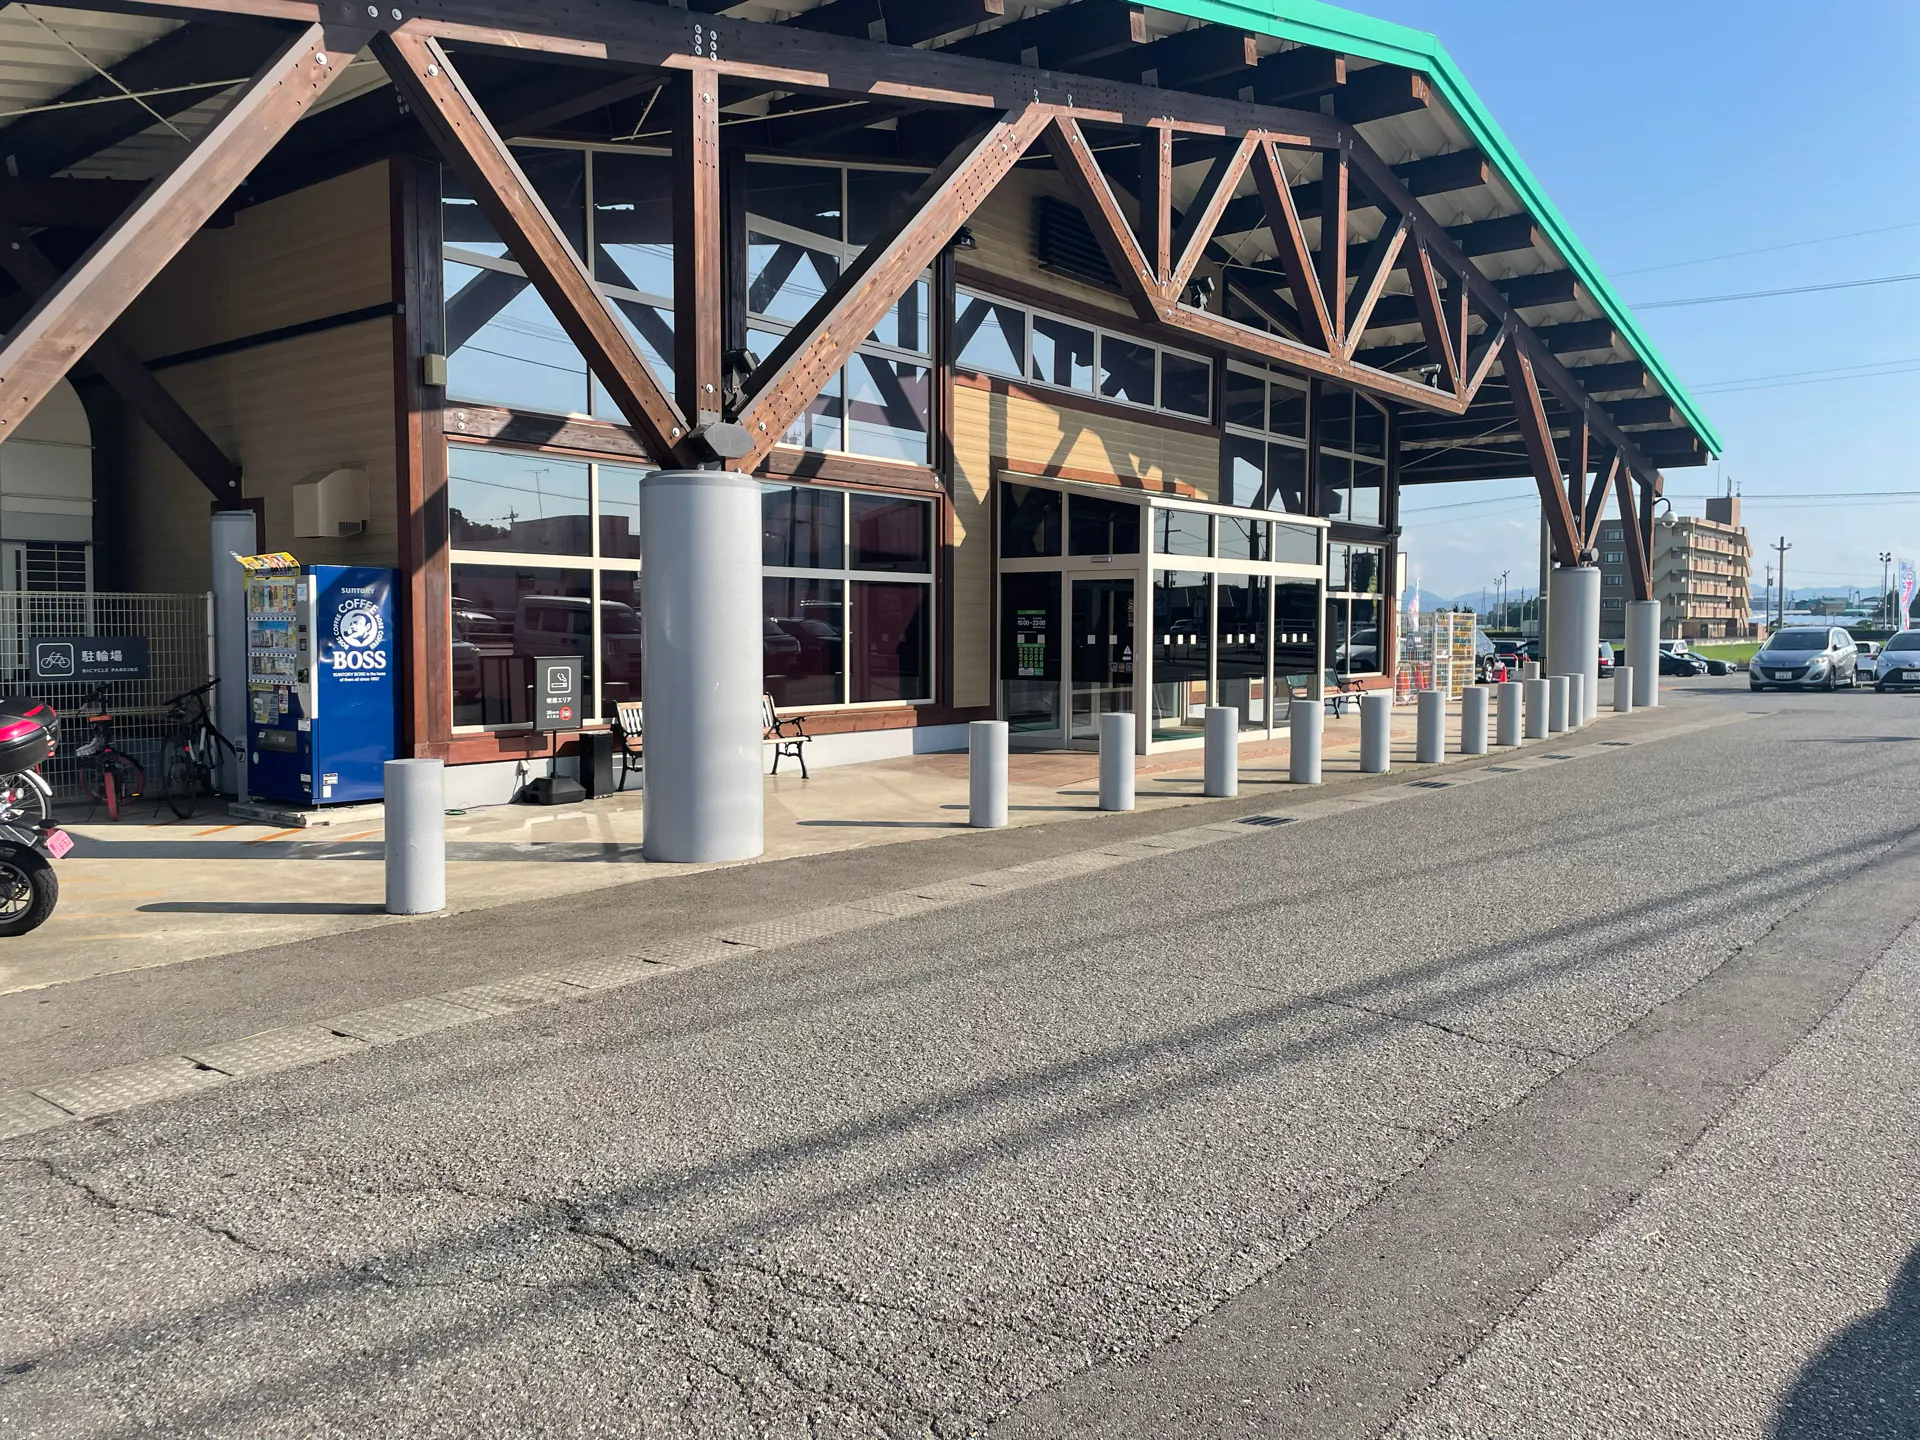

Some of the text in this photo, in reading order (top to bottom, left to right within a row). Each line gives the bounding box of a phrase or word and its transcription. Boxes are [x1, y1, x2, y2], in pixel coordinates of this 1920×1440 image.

[338, 599, 379, 614] COFFEE
[81, 650, 123, 662] 駐輪場
[332, 650, 387, 670] BOSS
